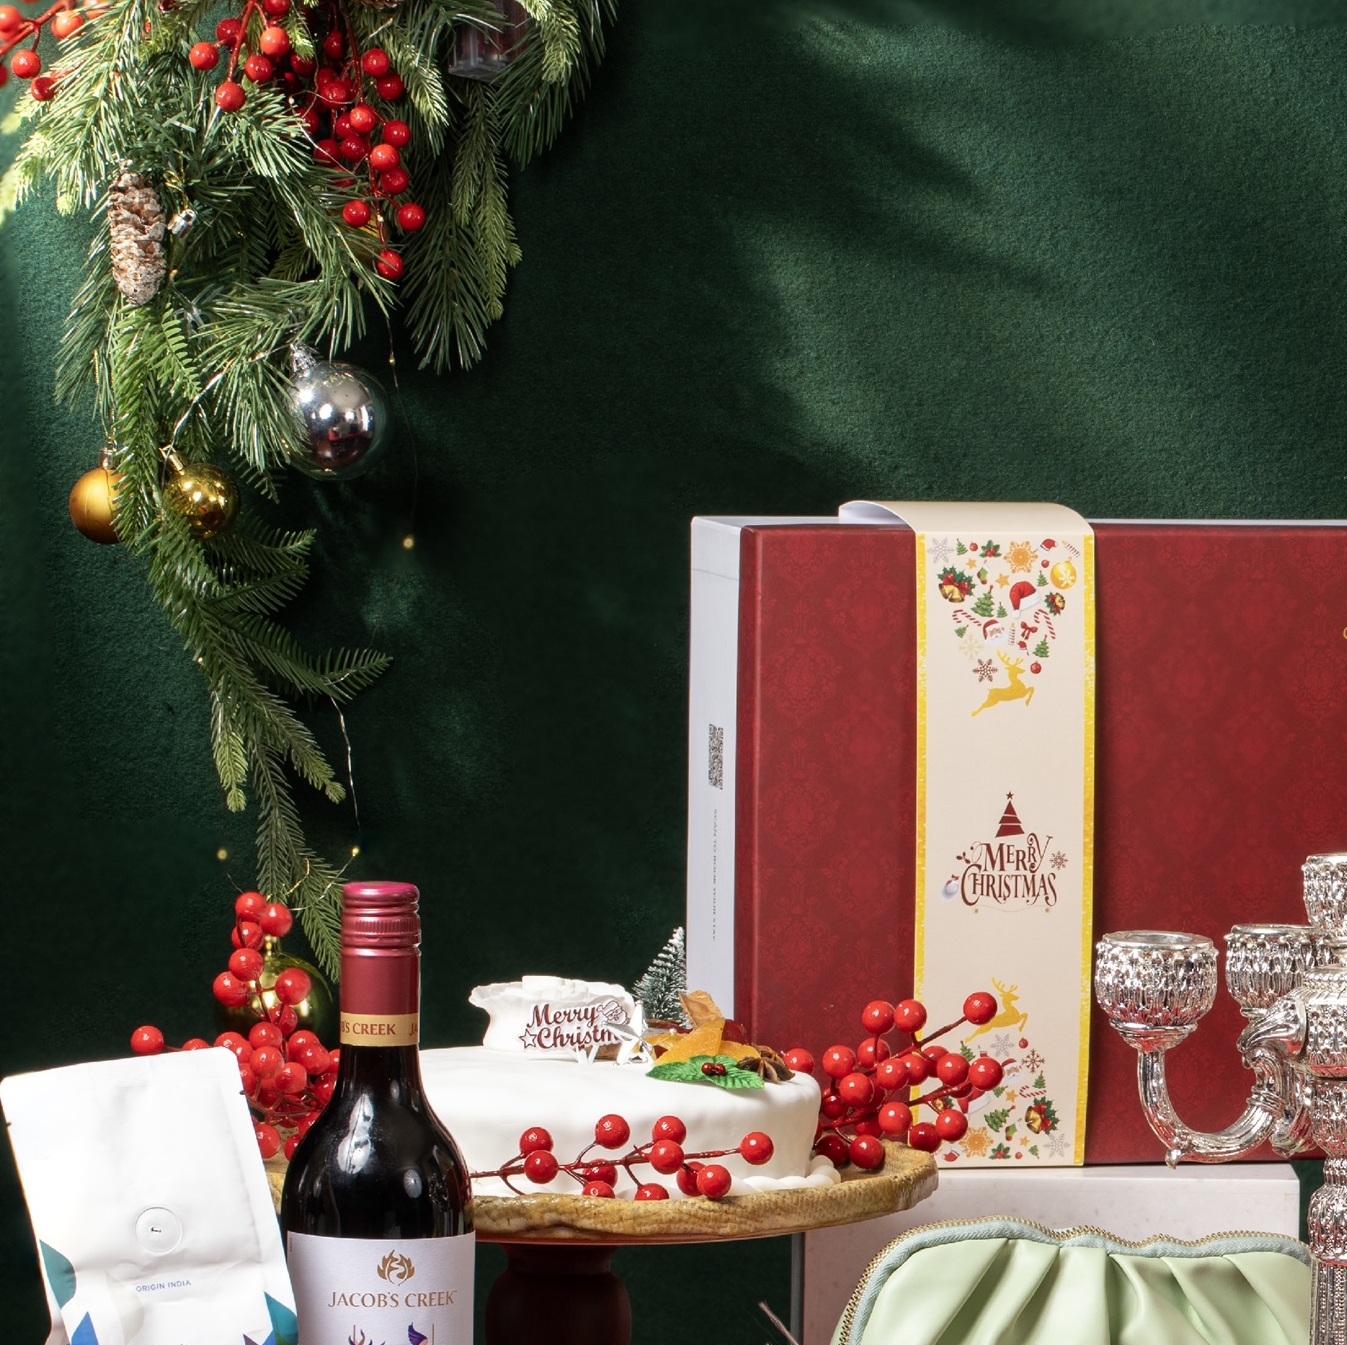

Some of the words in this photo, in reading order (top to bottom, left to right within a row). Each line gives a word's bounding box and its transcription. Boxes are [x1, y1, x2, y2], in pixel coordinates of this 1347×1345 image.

[526, 1003, 600, 1028] Merry
[352, 1022, 396, 1036] CREEK
[536, 1025, 618, 1049] Christm
[136, 1283, 165, 1293] ORIGIN
[167, 1280, 192, 1289] INDIA
[328, 1291, 399, 1308] JACOB'S
[405, 1291, 456, 1308] CREEK
